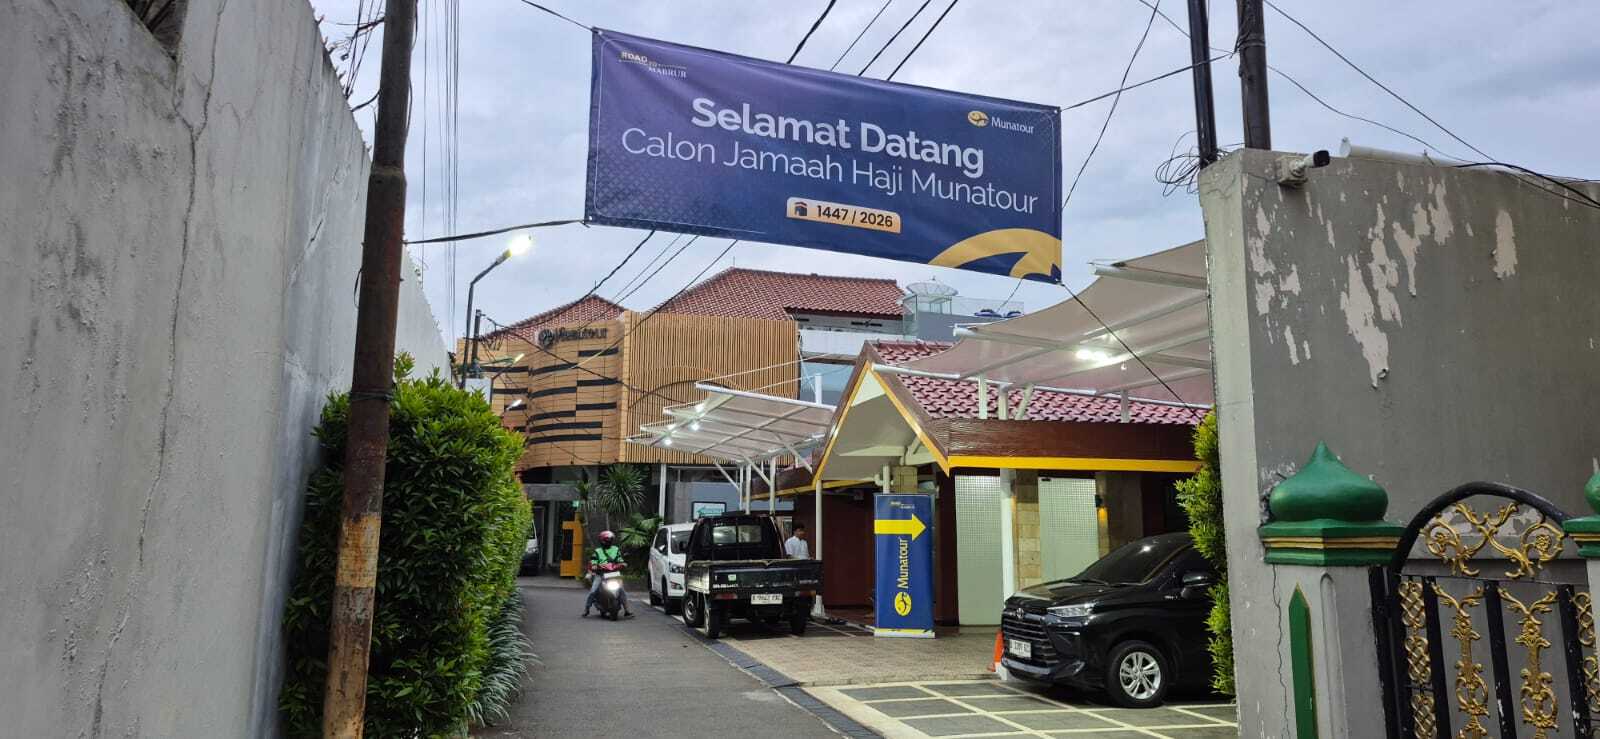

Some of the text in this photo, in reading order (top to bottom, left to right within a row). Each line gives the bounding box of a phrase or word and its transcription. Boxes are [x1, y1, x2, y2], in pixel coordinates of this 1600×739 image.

[691, 97, 984, 179] Selamat Datang
[991, 115, 1035, 135] Munatour
[621, 127, 1038, 215] Calon Jamaah Haji Munatour
[816, 204, 893, 229] 1447 / 2026
[897, 537, 909, 589] Munatour
